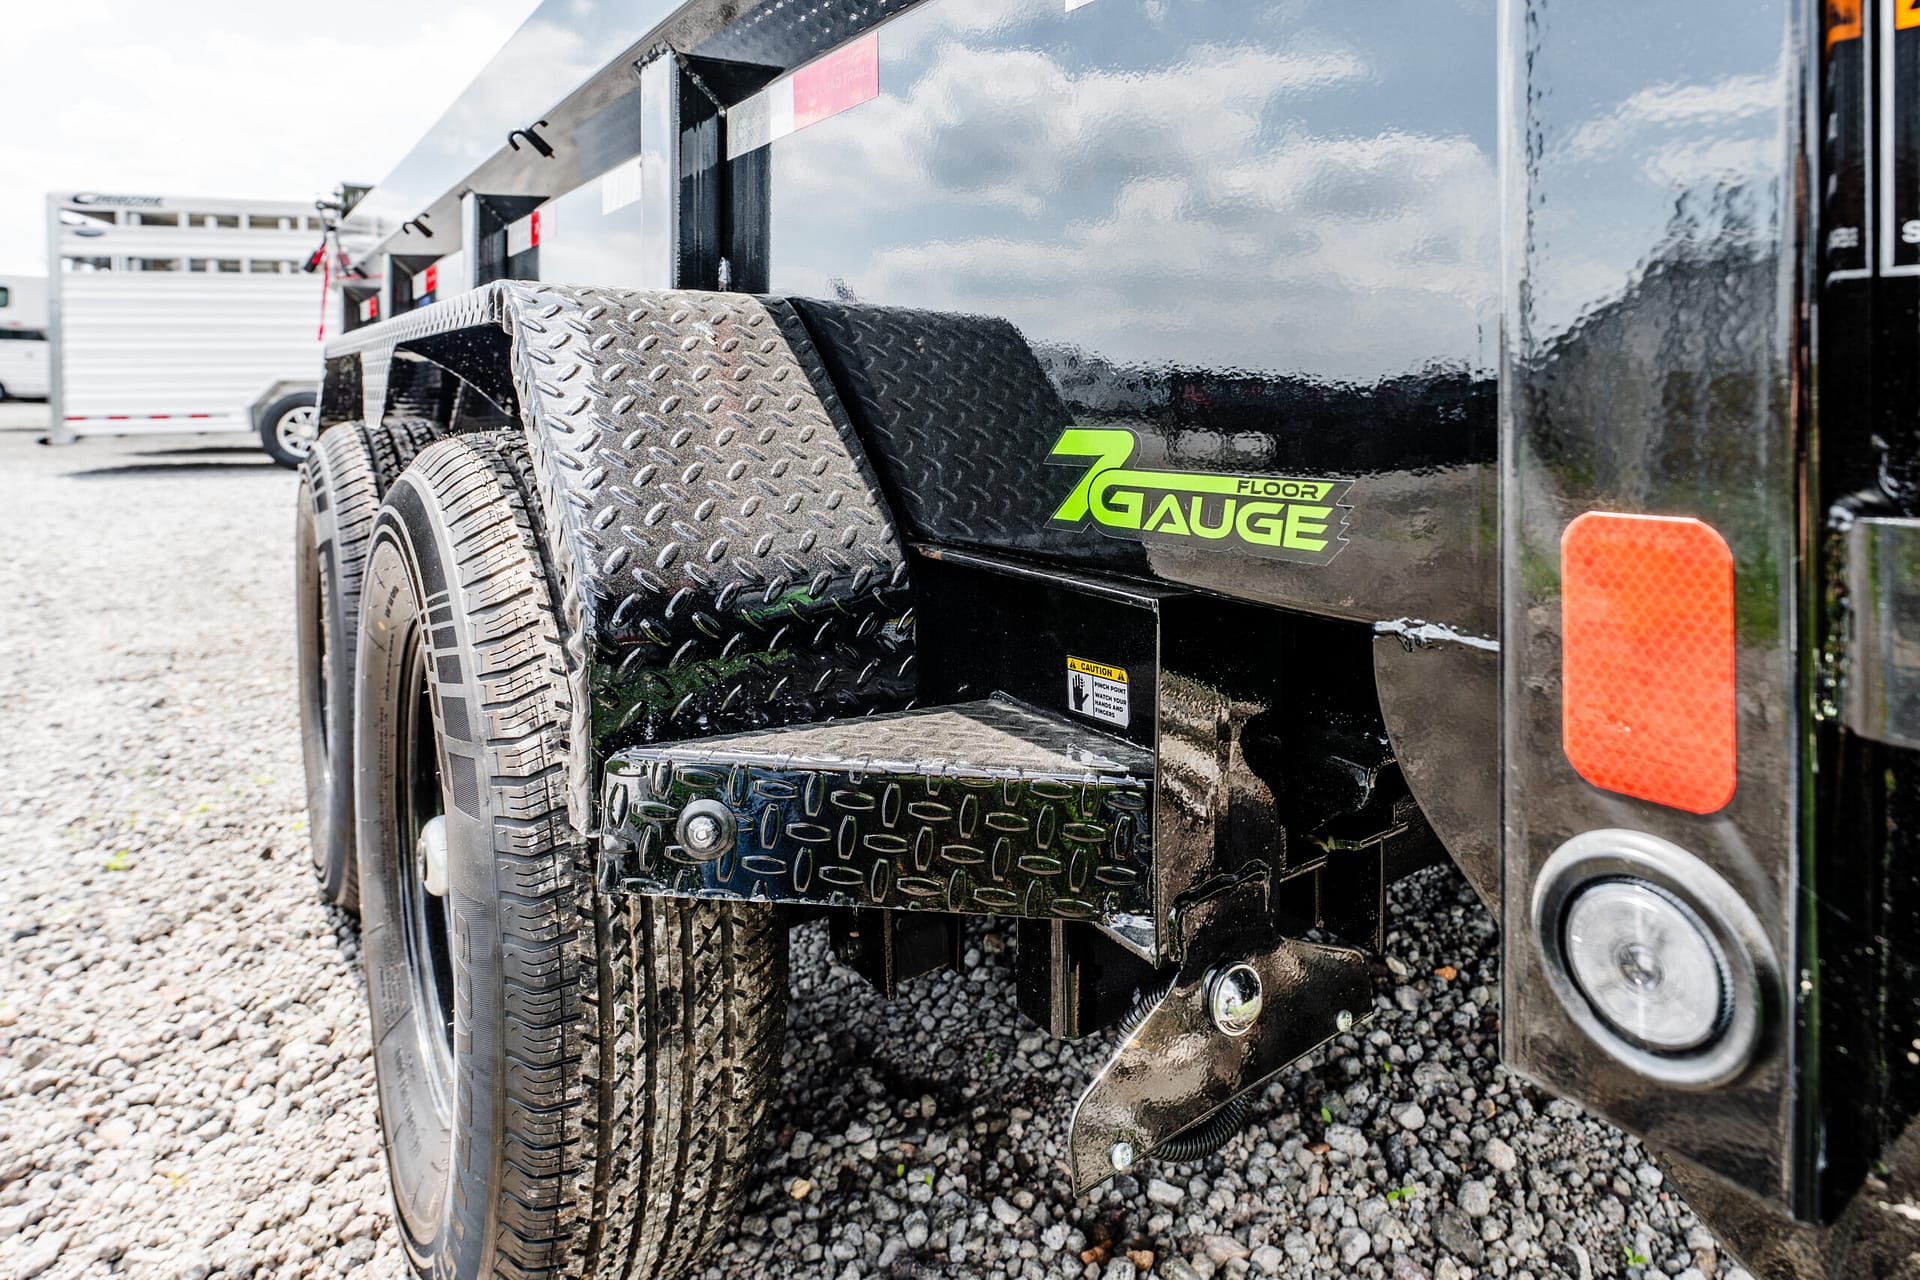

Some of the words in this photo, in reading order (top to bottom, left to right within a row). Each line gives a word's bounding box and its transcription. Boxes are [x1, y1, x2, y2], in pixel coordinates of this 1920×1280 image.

[1052, 429, 1134, 522] 7
[1237, 480, 1319, 499] FLOOR
[1088, 469, 1334, 551] GAUGE
[1081, 663, 1113, 677] CAUTION
[1095, 681, 1109, 690] PINCH
[1110, 686, 1126, 694] POINT
[1095, 692, 1112, 701] WATCH
[1113, 697, 1127, 705] YOUR
[1095, 699, 1111, 709] HANDS
[1095, 707, 1115, 718] FINGERS
